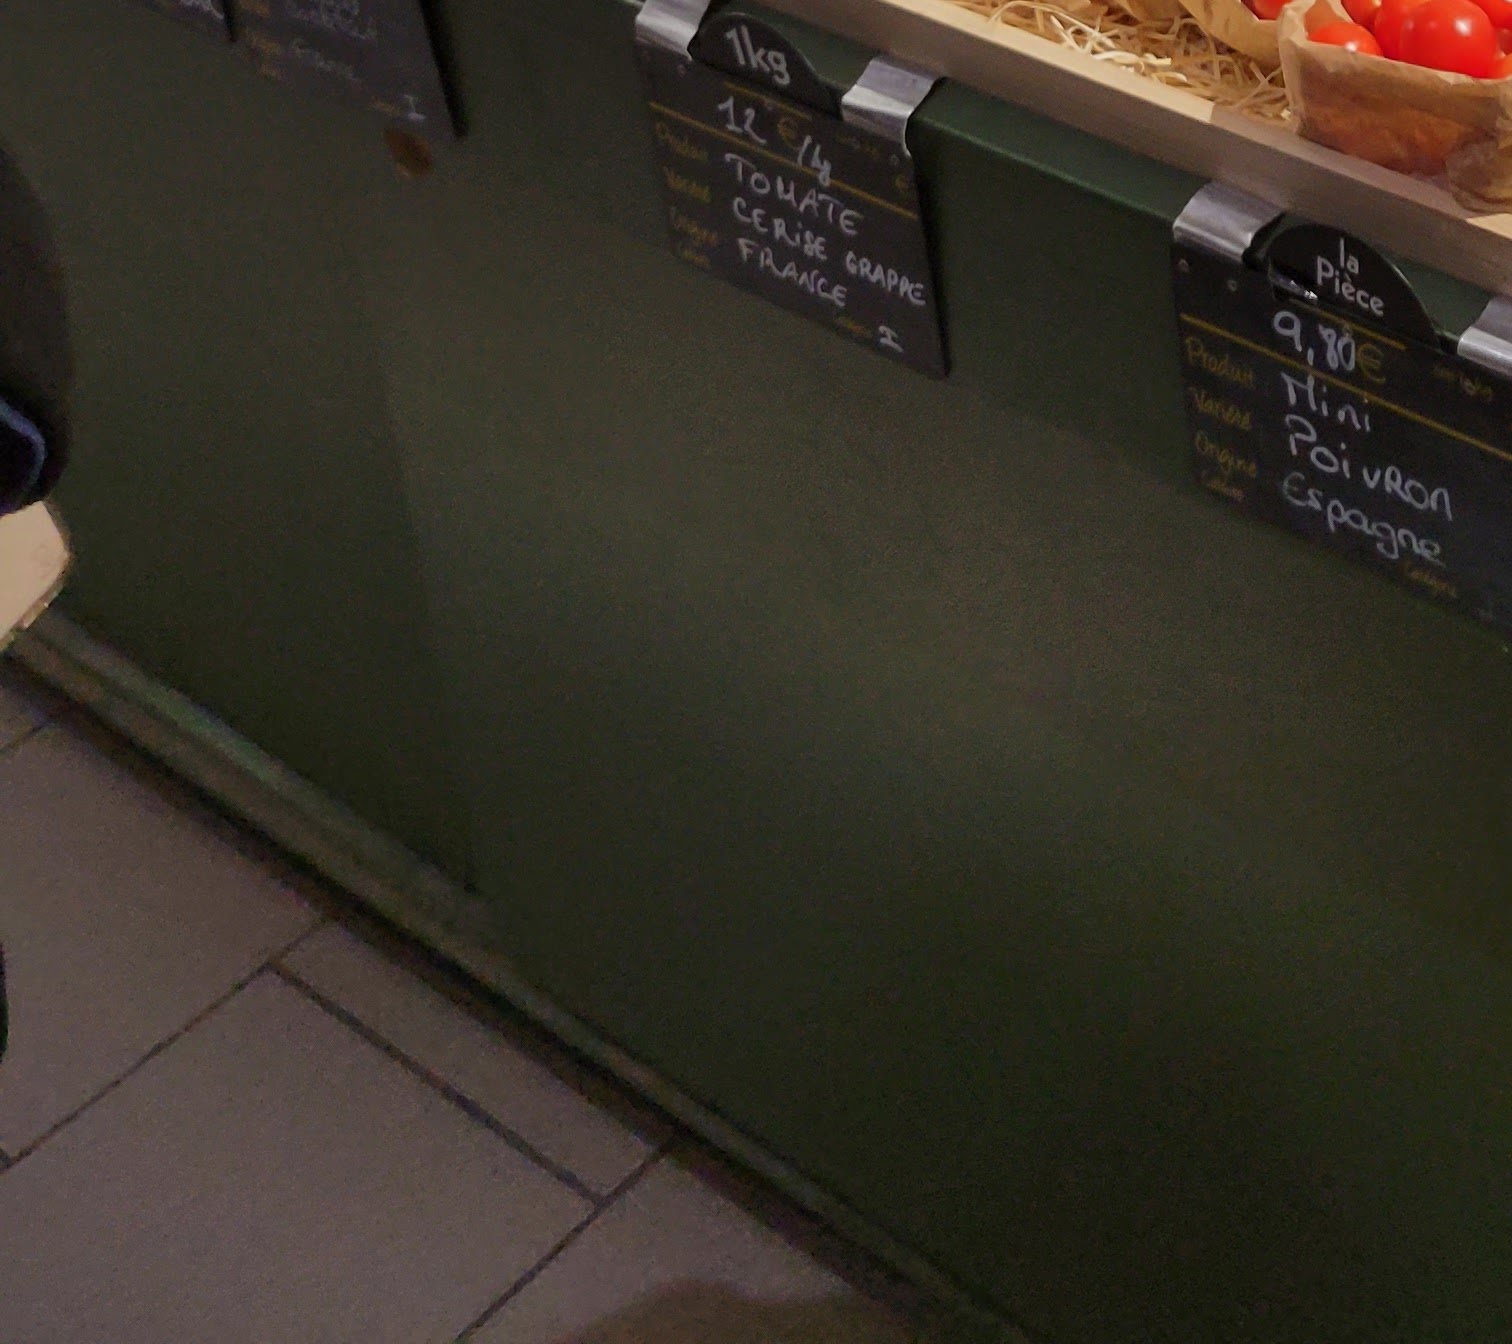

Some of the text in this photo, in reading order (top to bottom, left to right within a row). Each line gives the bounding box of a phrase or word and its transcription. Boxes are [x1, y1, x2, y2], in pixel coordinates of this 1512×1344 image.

[725, 25, 791, 87] 1kg
[718, 95, 767, 146] 12
[725, 151, 863, 236] TOMATE
[737, 236, 848, 308] FRANCE
[846, 250, 927, 307] GRAPPE
[1316, 256, 1386, 318] Pièce
[1340, 237, 1360, 275] la
[1282, 471, 1447, 568] Espagne
